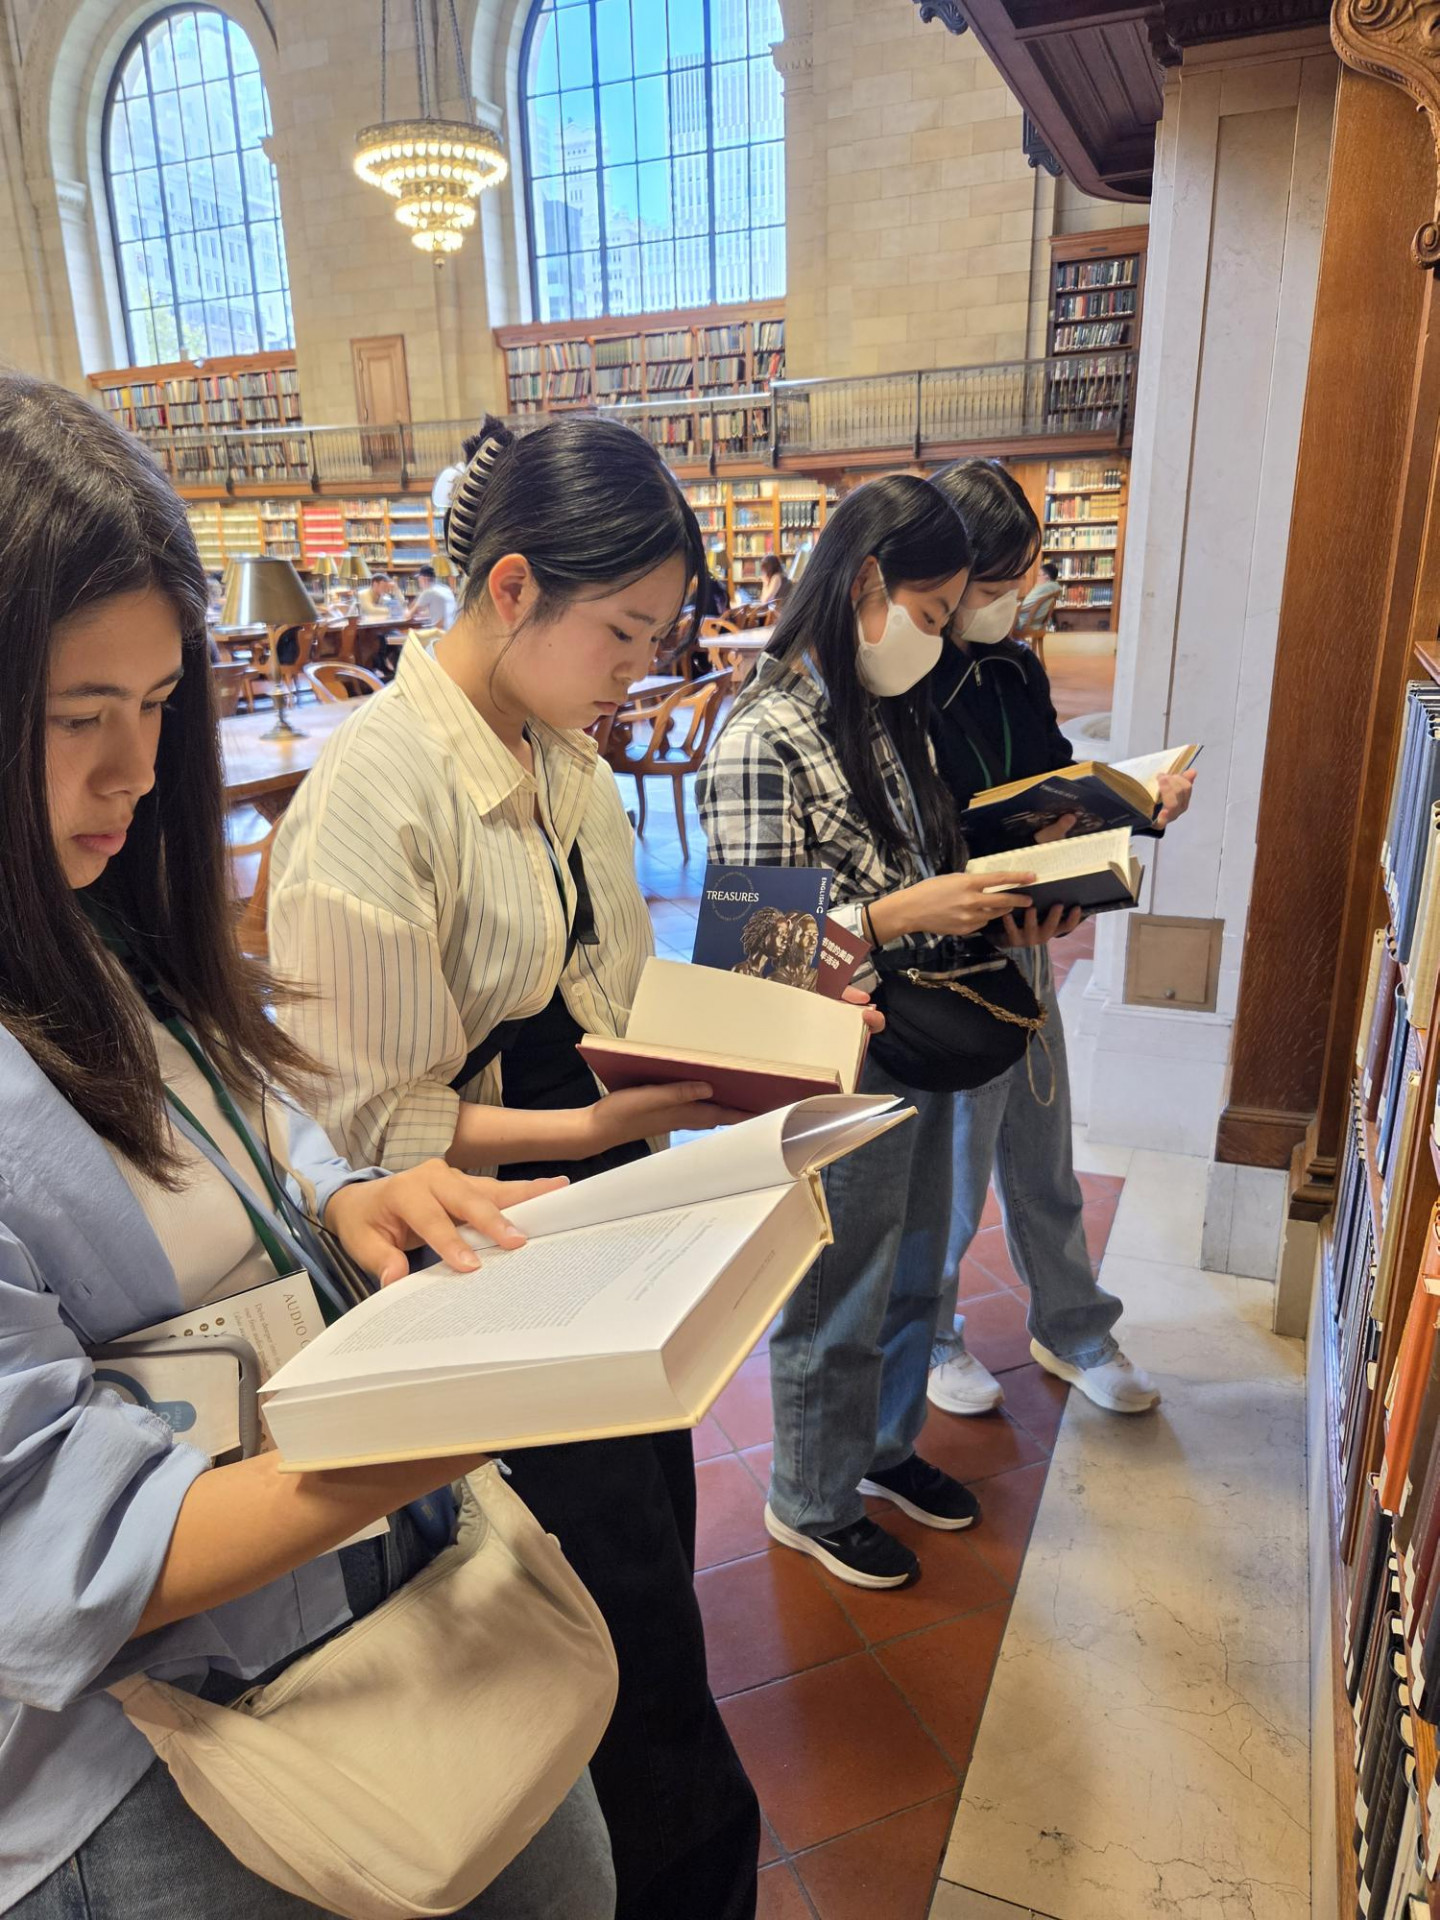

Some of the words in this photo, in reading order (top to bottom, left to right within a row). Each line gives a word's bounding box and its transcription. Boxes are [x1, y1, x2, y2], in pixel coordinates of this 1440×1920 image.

[706, 890, 760, 903] TREASURES
[819, 876, 828, 906] ENGLISH
[283, 1293, 308, 1337] AUDIO
